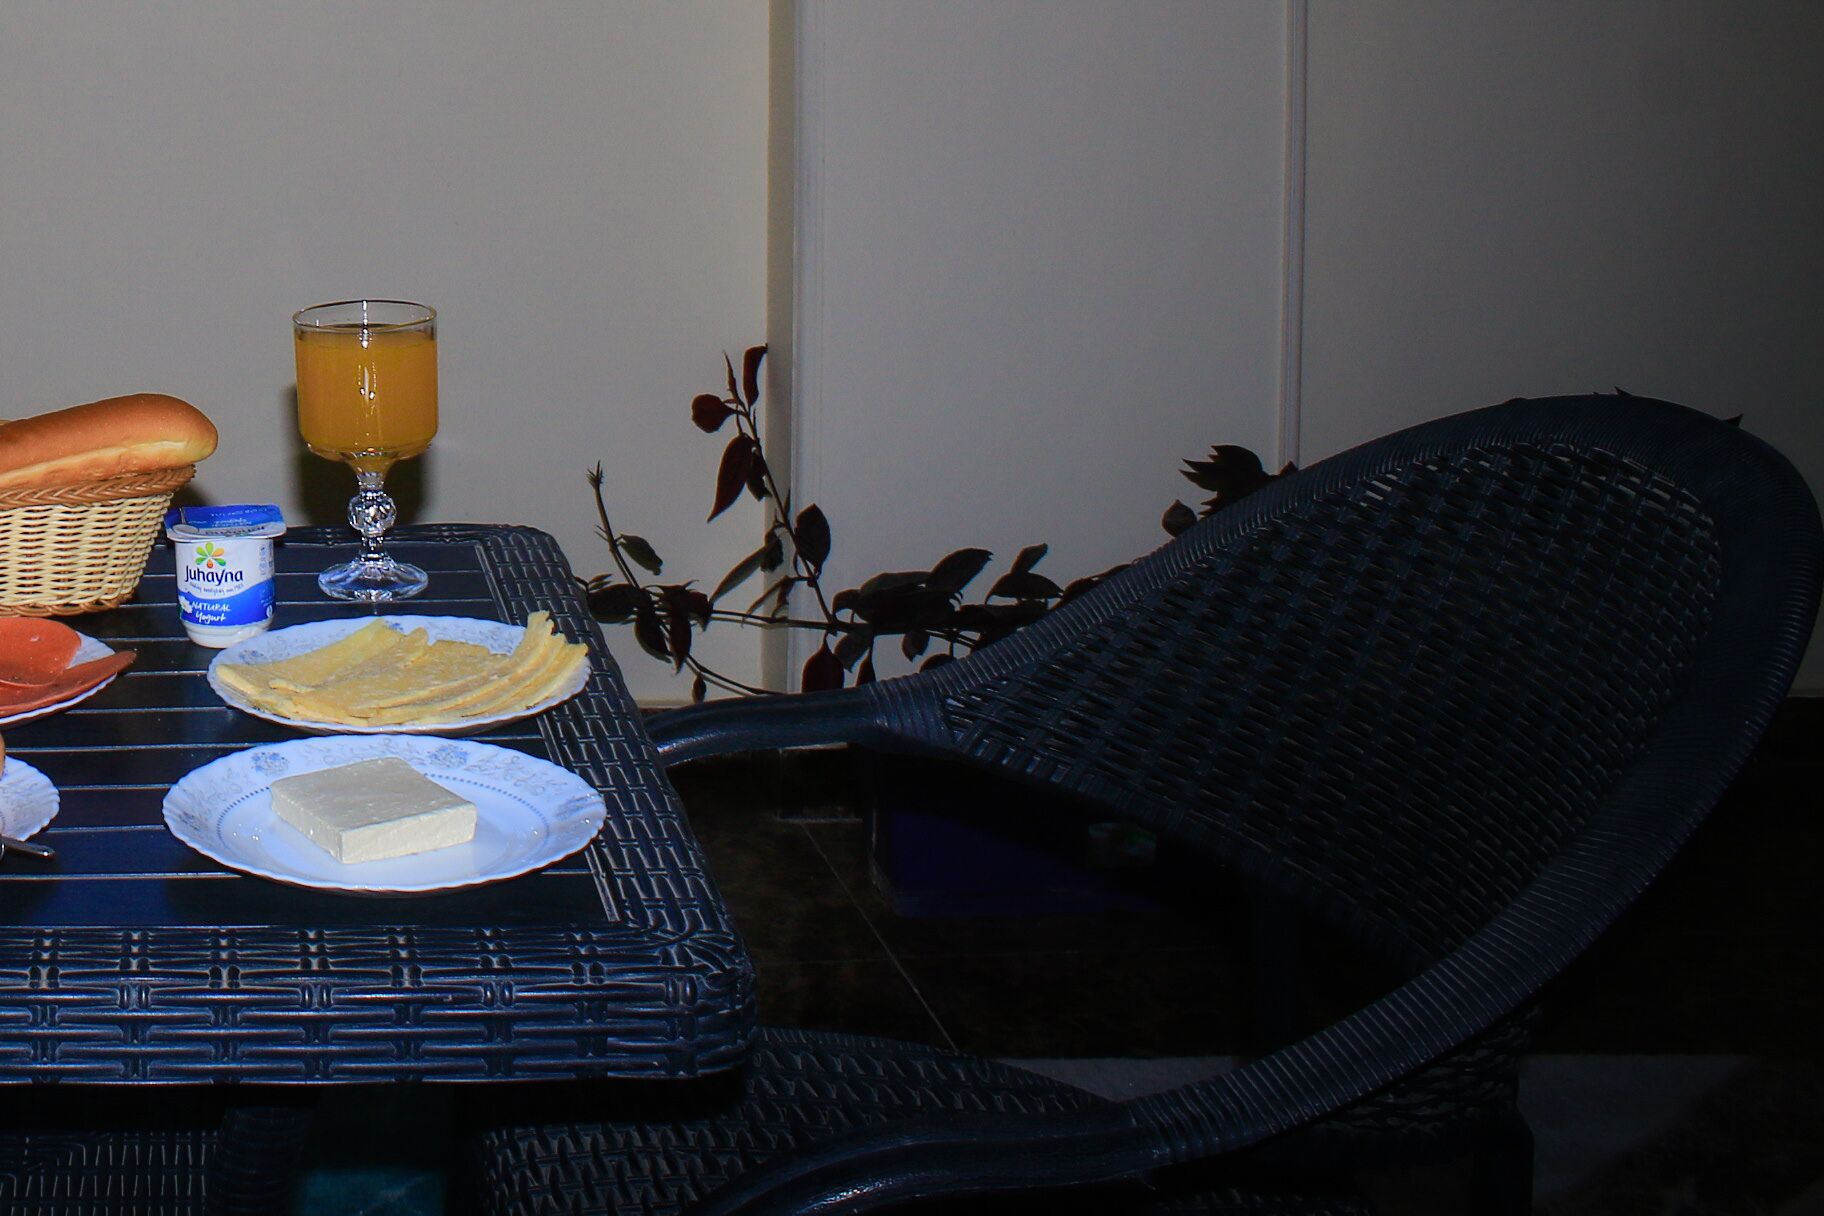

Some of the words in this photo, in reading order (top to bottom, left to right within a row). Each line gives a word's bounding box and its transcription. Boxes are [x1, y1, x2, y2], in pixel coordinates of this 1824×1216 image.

[184, 565, 243, 586] Juhayna
[191, 601, 231, 612] NATURAL
[195, 611, 226, 624] Yogurt
